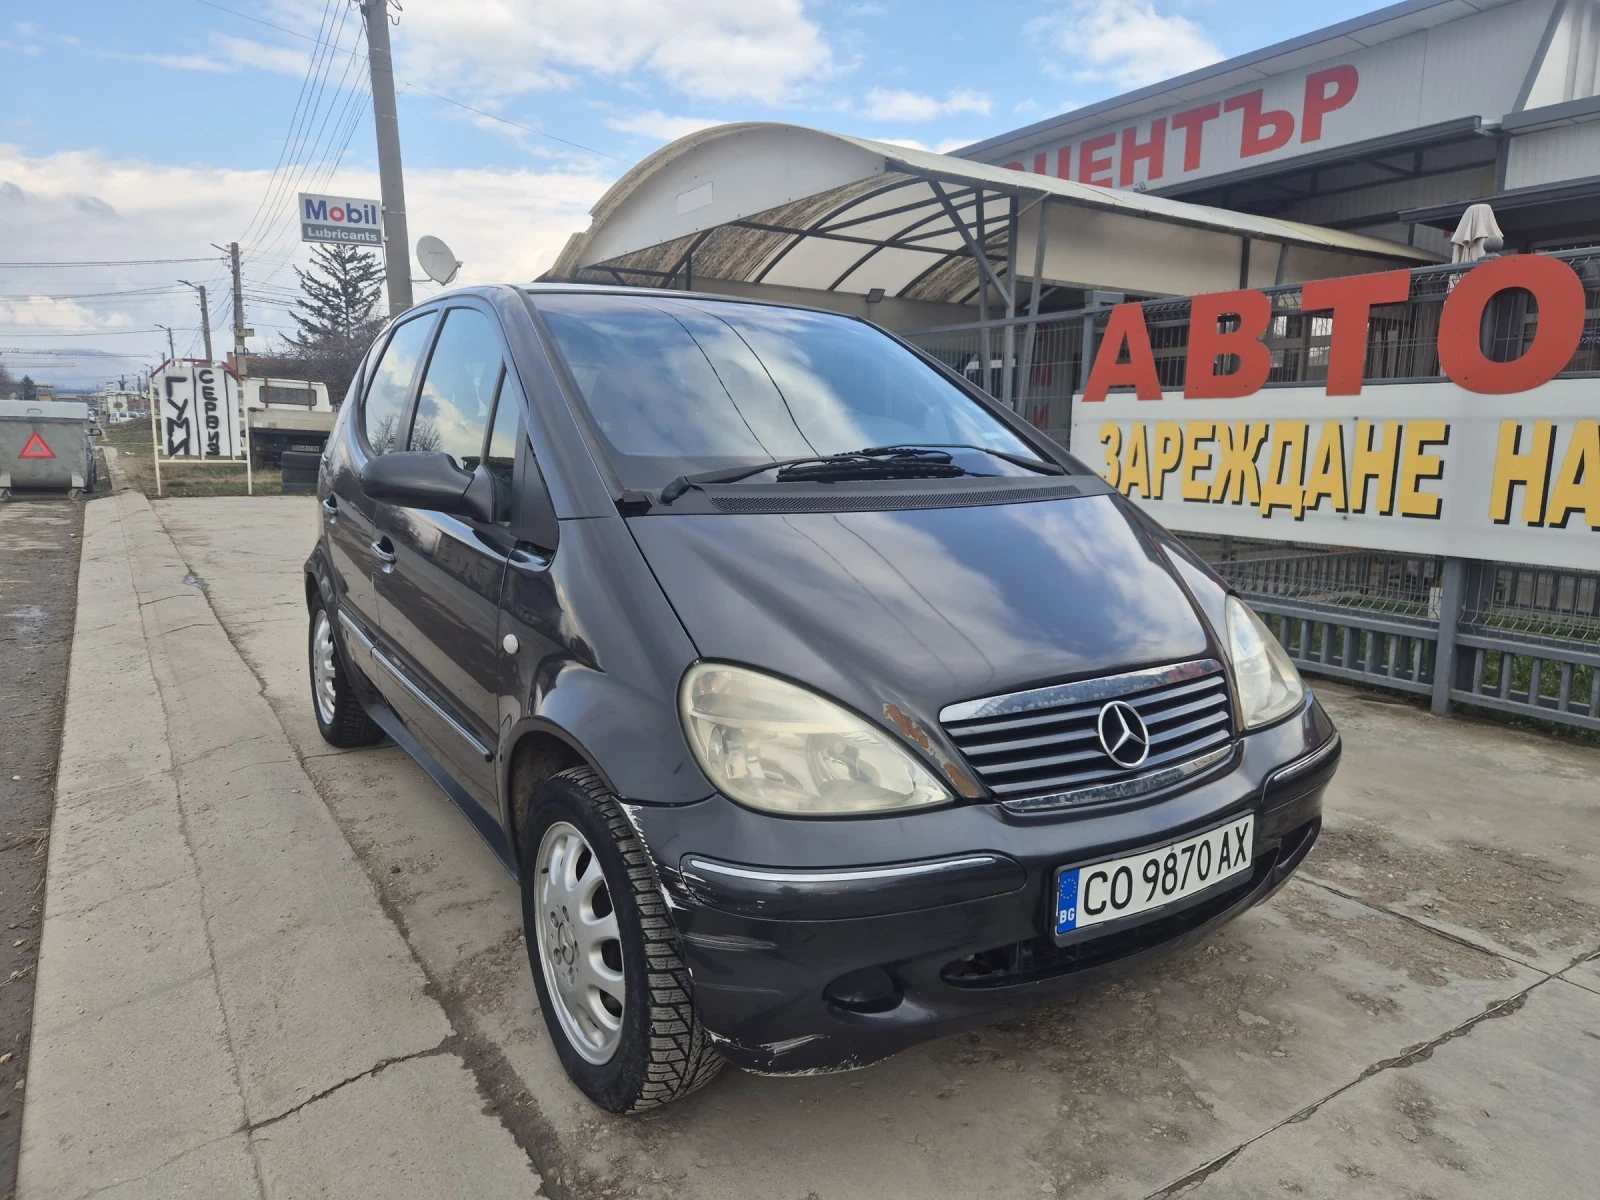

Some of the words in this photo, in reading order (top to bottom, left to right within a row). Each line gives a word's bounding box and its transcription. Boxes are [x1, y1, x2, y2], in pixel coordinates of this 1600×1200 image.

[1002, 64, 1359, 189] ЕНТЪР
[305, 198, 377, 225] Mobil
[307, 227, 378, 242] Lubricants
[1082, 253, 1586, 402] АВТО
[166, 376, 191, 457] ГУМИ
[199, 369, 221, 456] СЕРВИЗ
[1099, 419, 1450, 521] ЗАРЕЖДАНЕ
[1488, 417, 1600, 532] НА
[1142, 839, 1212, 903] 9870
[1059, 907, 1075, 924] BG
